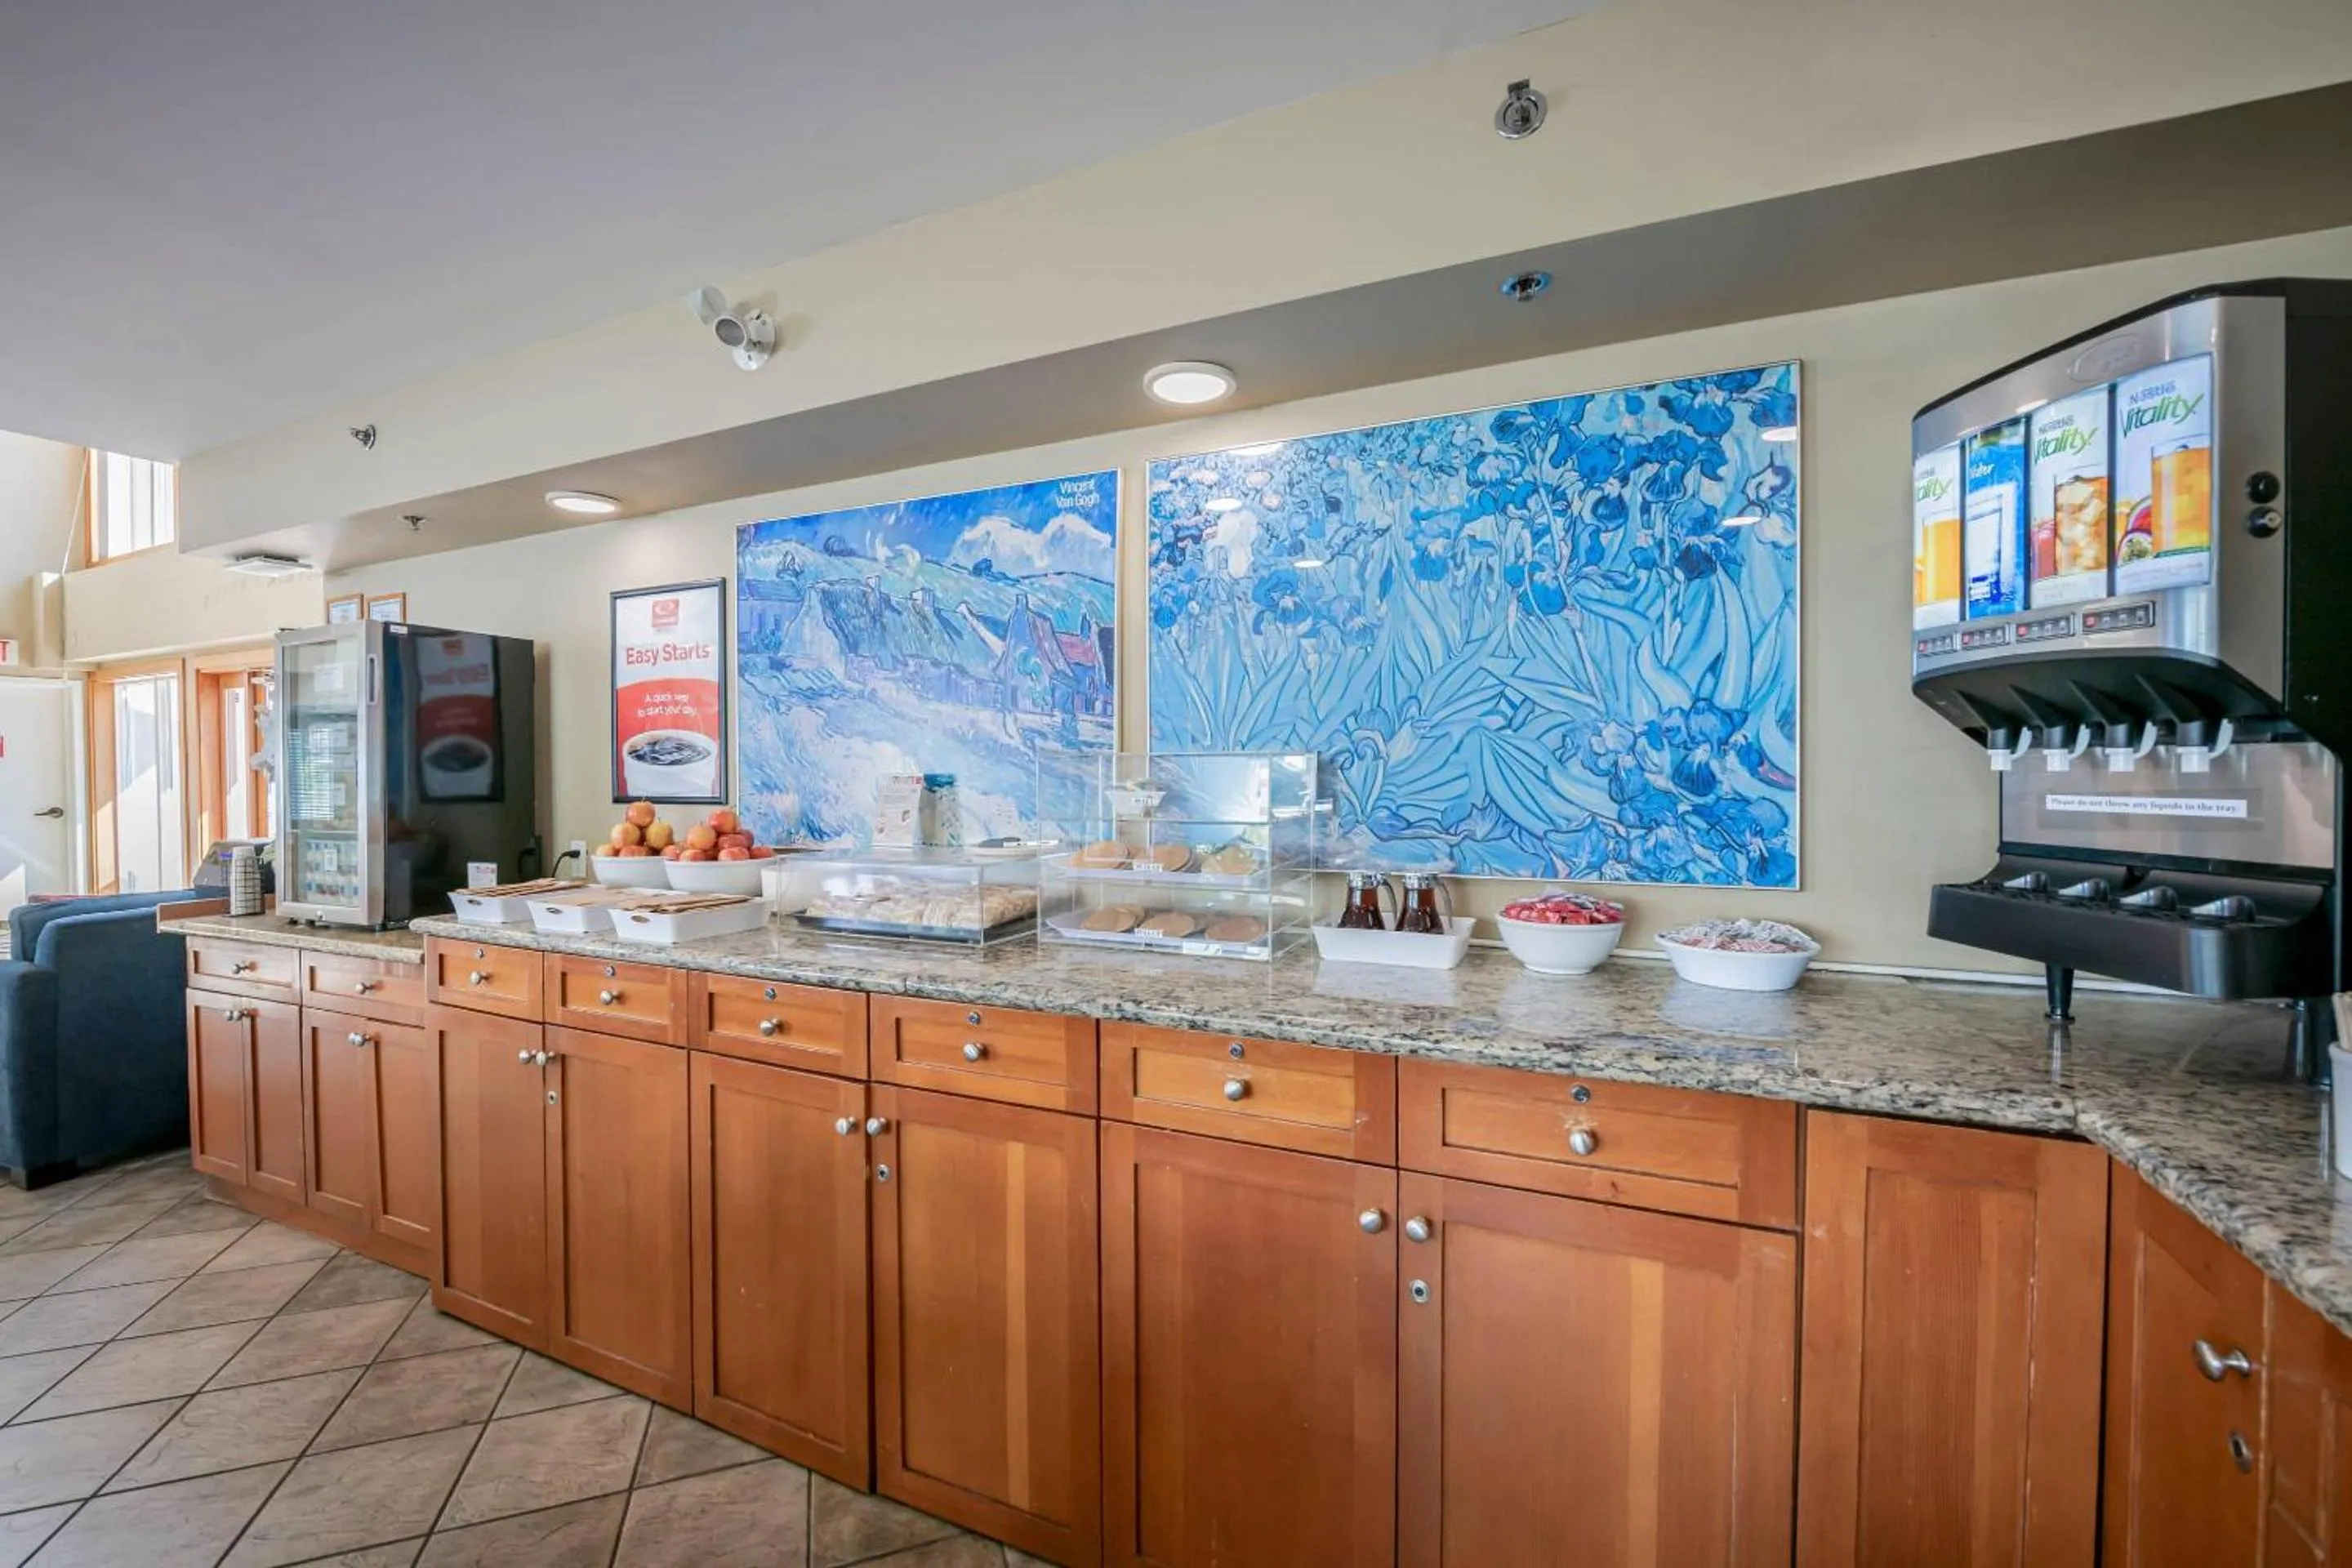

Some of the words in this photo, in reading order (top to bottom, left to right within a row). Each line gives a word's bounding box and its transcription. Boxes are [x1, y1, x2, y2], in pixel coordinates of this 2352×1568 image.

[2120, 394, 2203, 439] Vitality
[1060, 479, 1095, 494] Vincent
[1057, 497, 1073, 508] Van
[1076, 492, 1099, 507] Gogh
[626, 647, 659, 666] Easy
[662, 642, 710, 662] Starts
[2198, 803, 2213, 811] the
